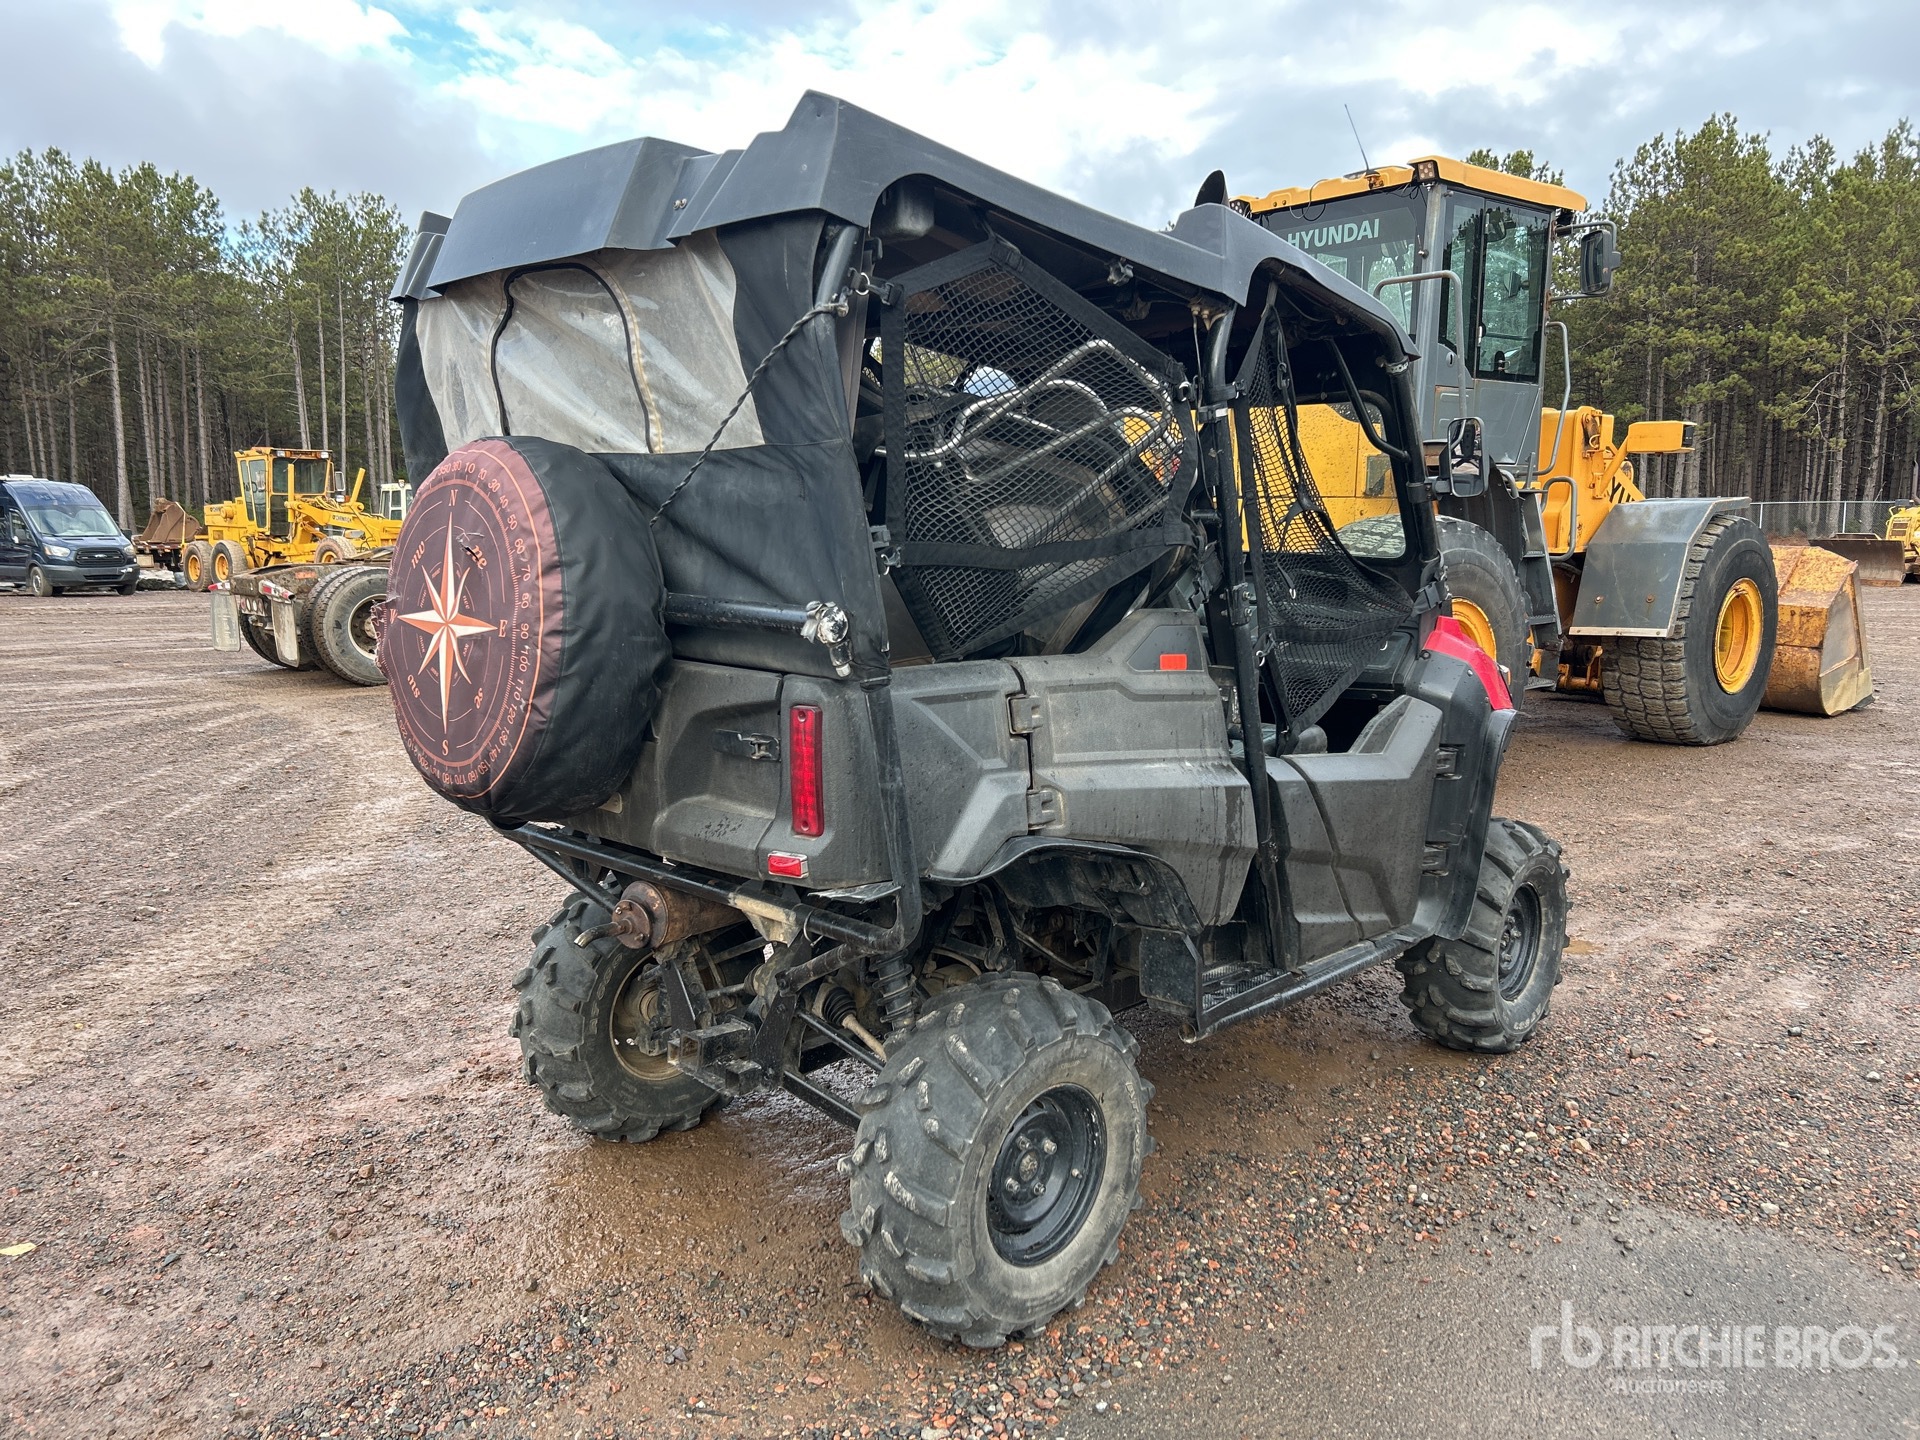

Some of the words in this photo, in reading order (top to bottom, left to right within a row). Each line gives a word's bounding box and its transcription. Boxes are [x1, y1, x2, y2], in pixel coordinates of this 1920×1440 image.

[1287, 218, 1380, 250] HYUNDAI
[465, 461, 476, 474] 10
[488, 479, 500, 492] 30
[449, 489, 459, 507] N
[499, 495, 509, 509] 40
[507, 514, 518, 530] 50
[515, 538, 526, 554] 60
[521, 564, 531, 581] 70
[521, 592, 530, 609] 80
[498, 620, 508, 638] E
[521, 623, 530, 640] 90
[519, 649, 529, 672] 100
[513, 678, 524, 701] 110
[507, 703, 517, 724] 120
[499, 726, 510, 746] 130
[442, 739, 449, 756] S
[477, 759, 491, 775] 150
[454, 774, 467, 785] 170
